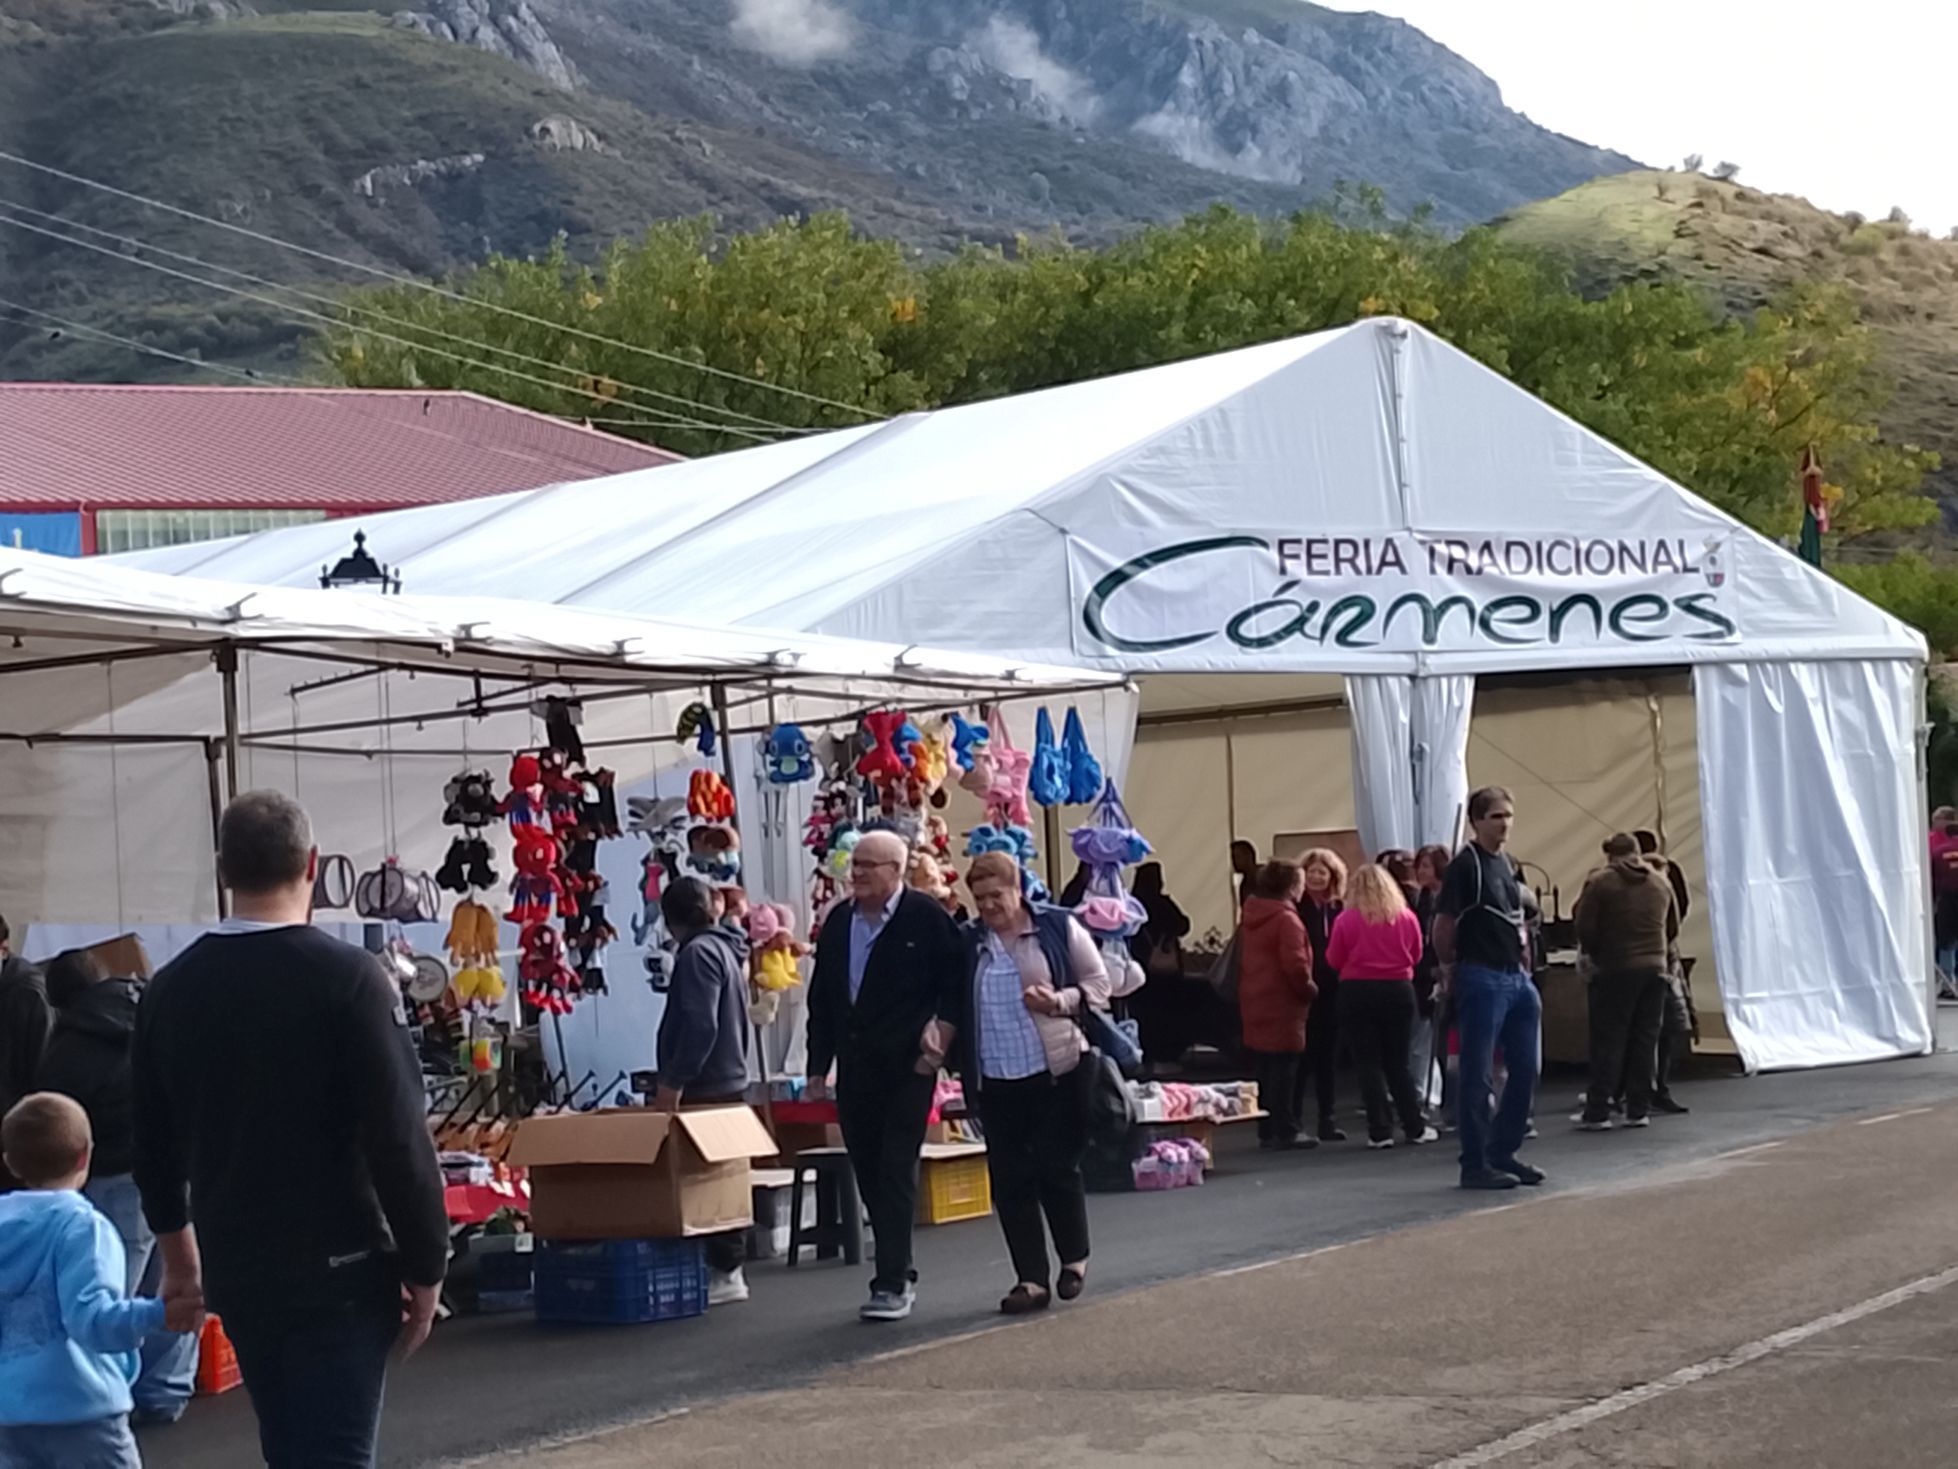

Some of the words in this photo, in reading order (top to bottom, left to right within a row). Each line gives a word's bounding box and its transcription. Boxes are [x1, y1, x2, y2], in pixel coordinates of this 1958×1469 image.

[1083, 536, 1736, 652] Cármenes
[1279, 536, 1407, 577] FERIA
[1420, 537, 1700, 577] TRADICIONAL
